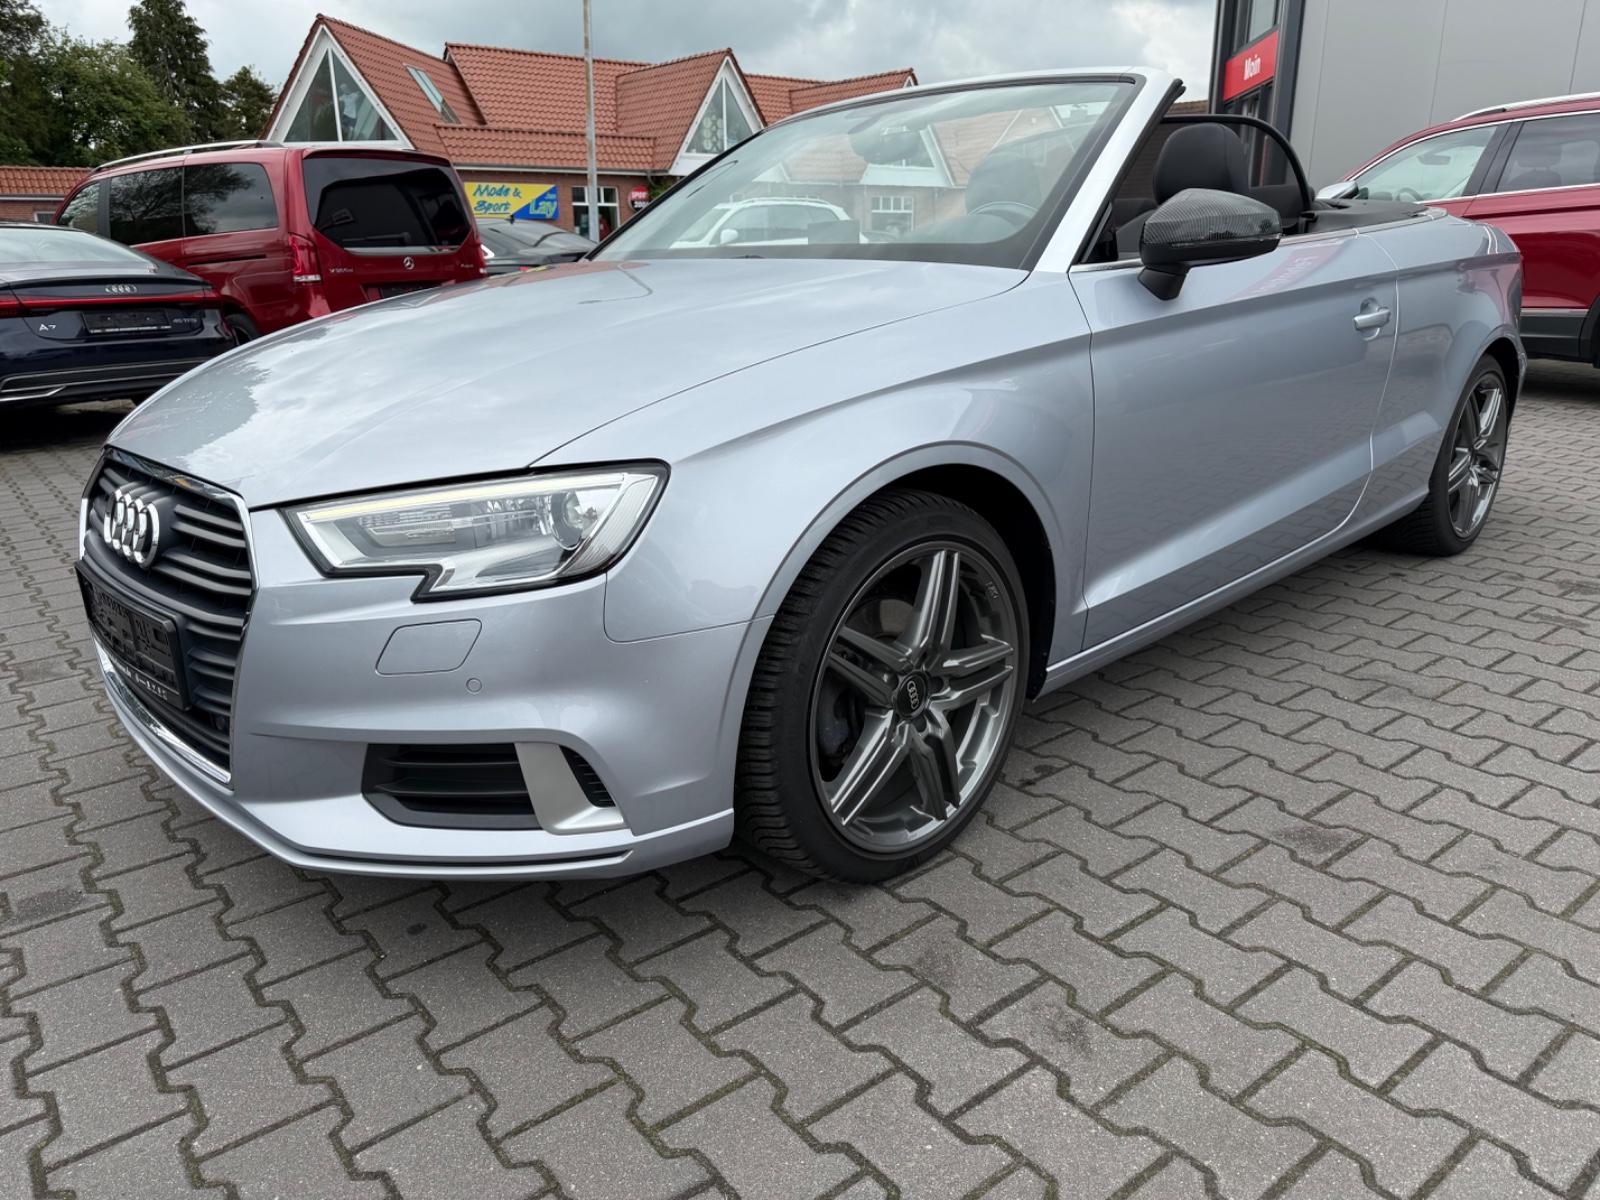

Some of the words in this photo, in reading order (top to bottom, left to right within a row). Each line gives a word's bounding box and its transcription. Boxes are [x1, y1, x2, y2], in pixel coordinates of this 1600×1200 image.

[473, 184, 511, 197] Mode
[512, 187, 522, 199] &
[474, 200, 511, 214] Sport
[39, 323, 57, 331] A7
